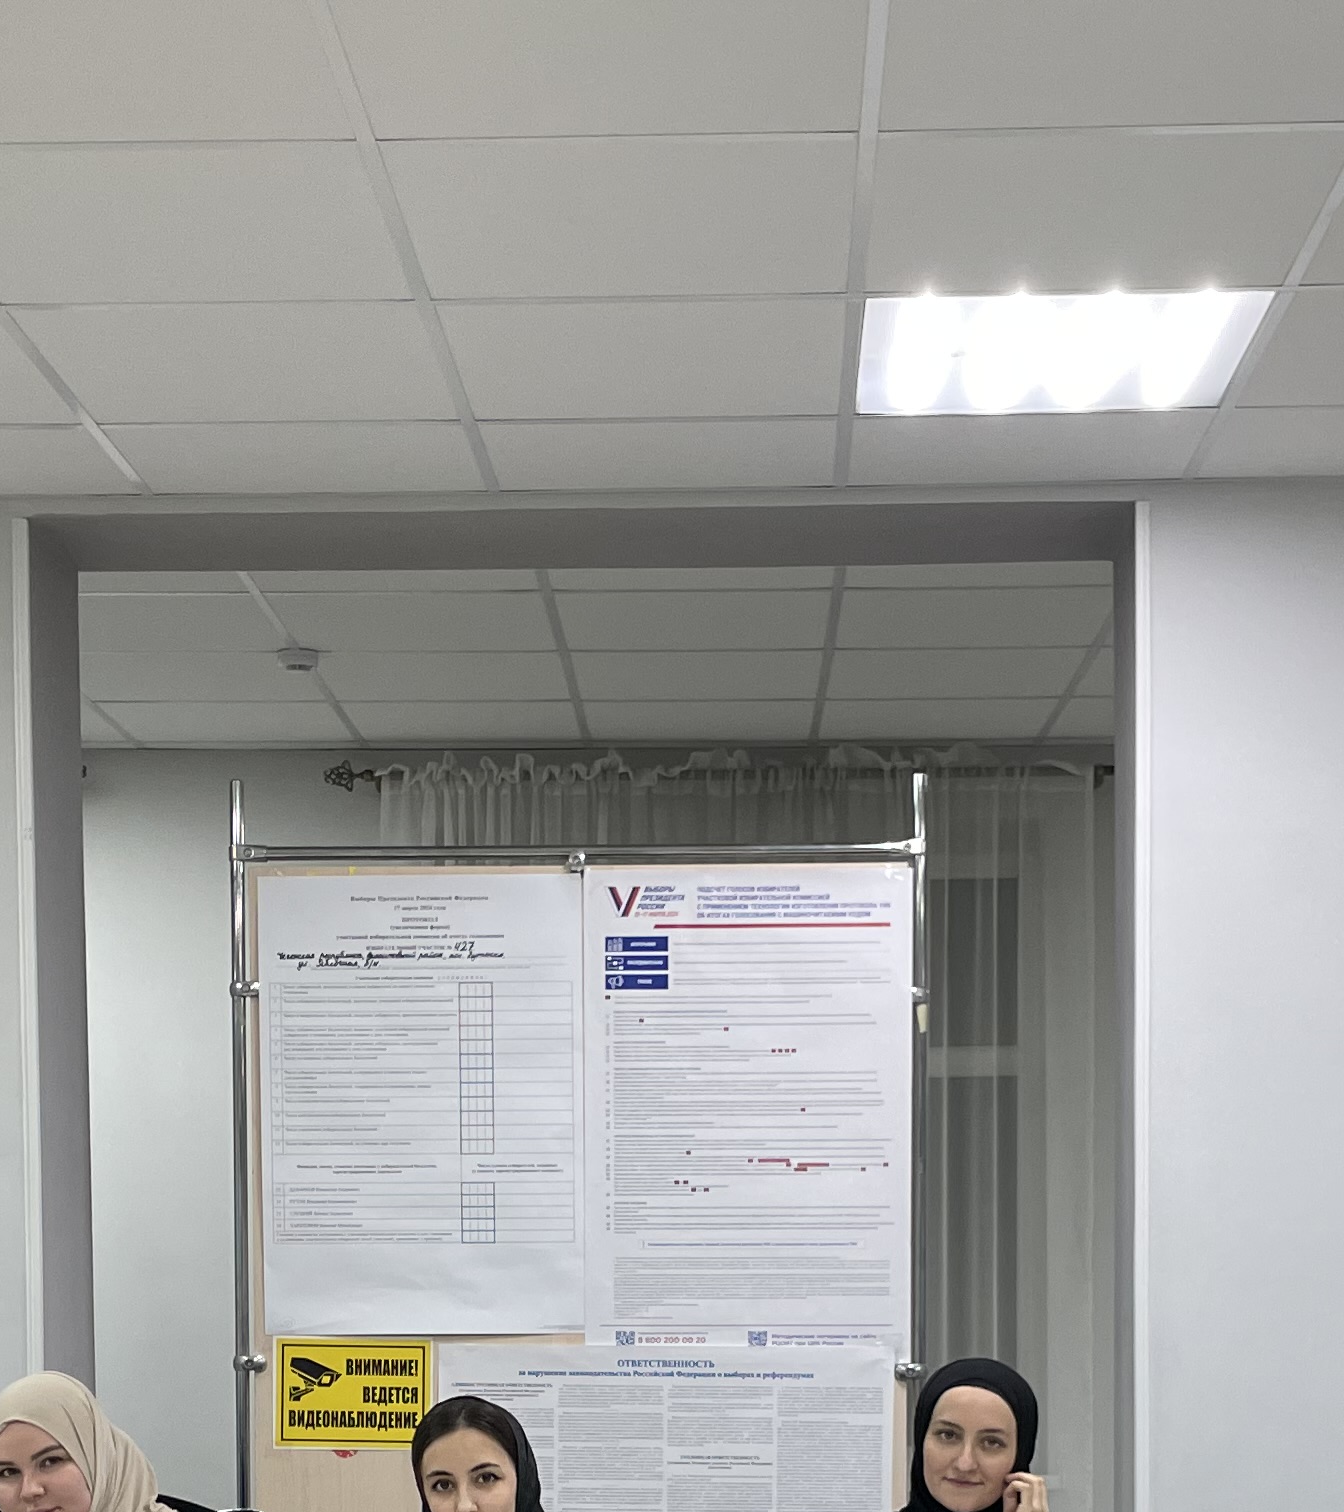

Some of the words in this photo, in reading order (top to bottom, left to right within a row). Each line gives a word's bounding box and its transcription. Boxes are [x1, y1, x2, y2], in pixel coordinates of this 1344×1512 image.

[454, 940, 475, 952] 427
[645, 1336, 662, 1344] 800
[664, 1336, 680, 1344] 200
[682, 1336, 694, 1344] 00
[696, 1336, 706, 1344] 20
[346, 1358, 419, 1377] ВНИМАНИЕ!
[617, 1359, 715, 1368] ОТВЕТСТВЕННОСТЬ
[362, 1386, 418, 1406] ВЕДЕТСЯ
[288, 1409, 418, 1432] ВИДЕОНАБЛЮДЕНИЕ
